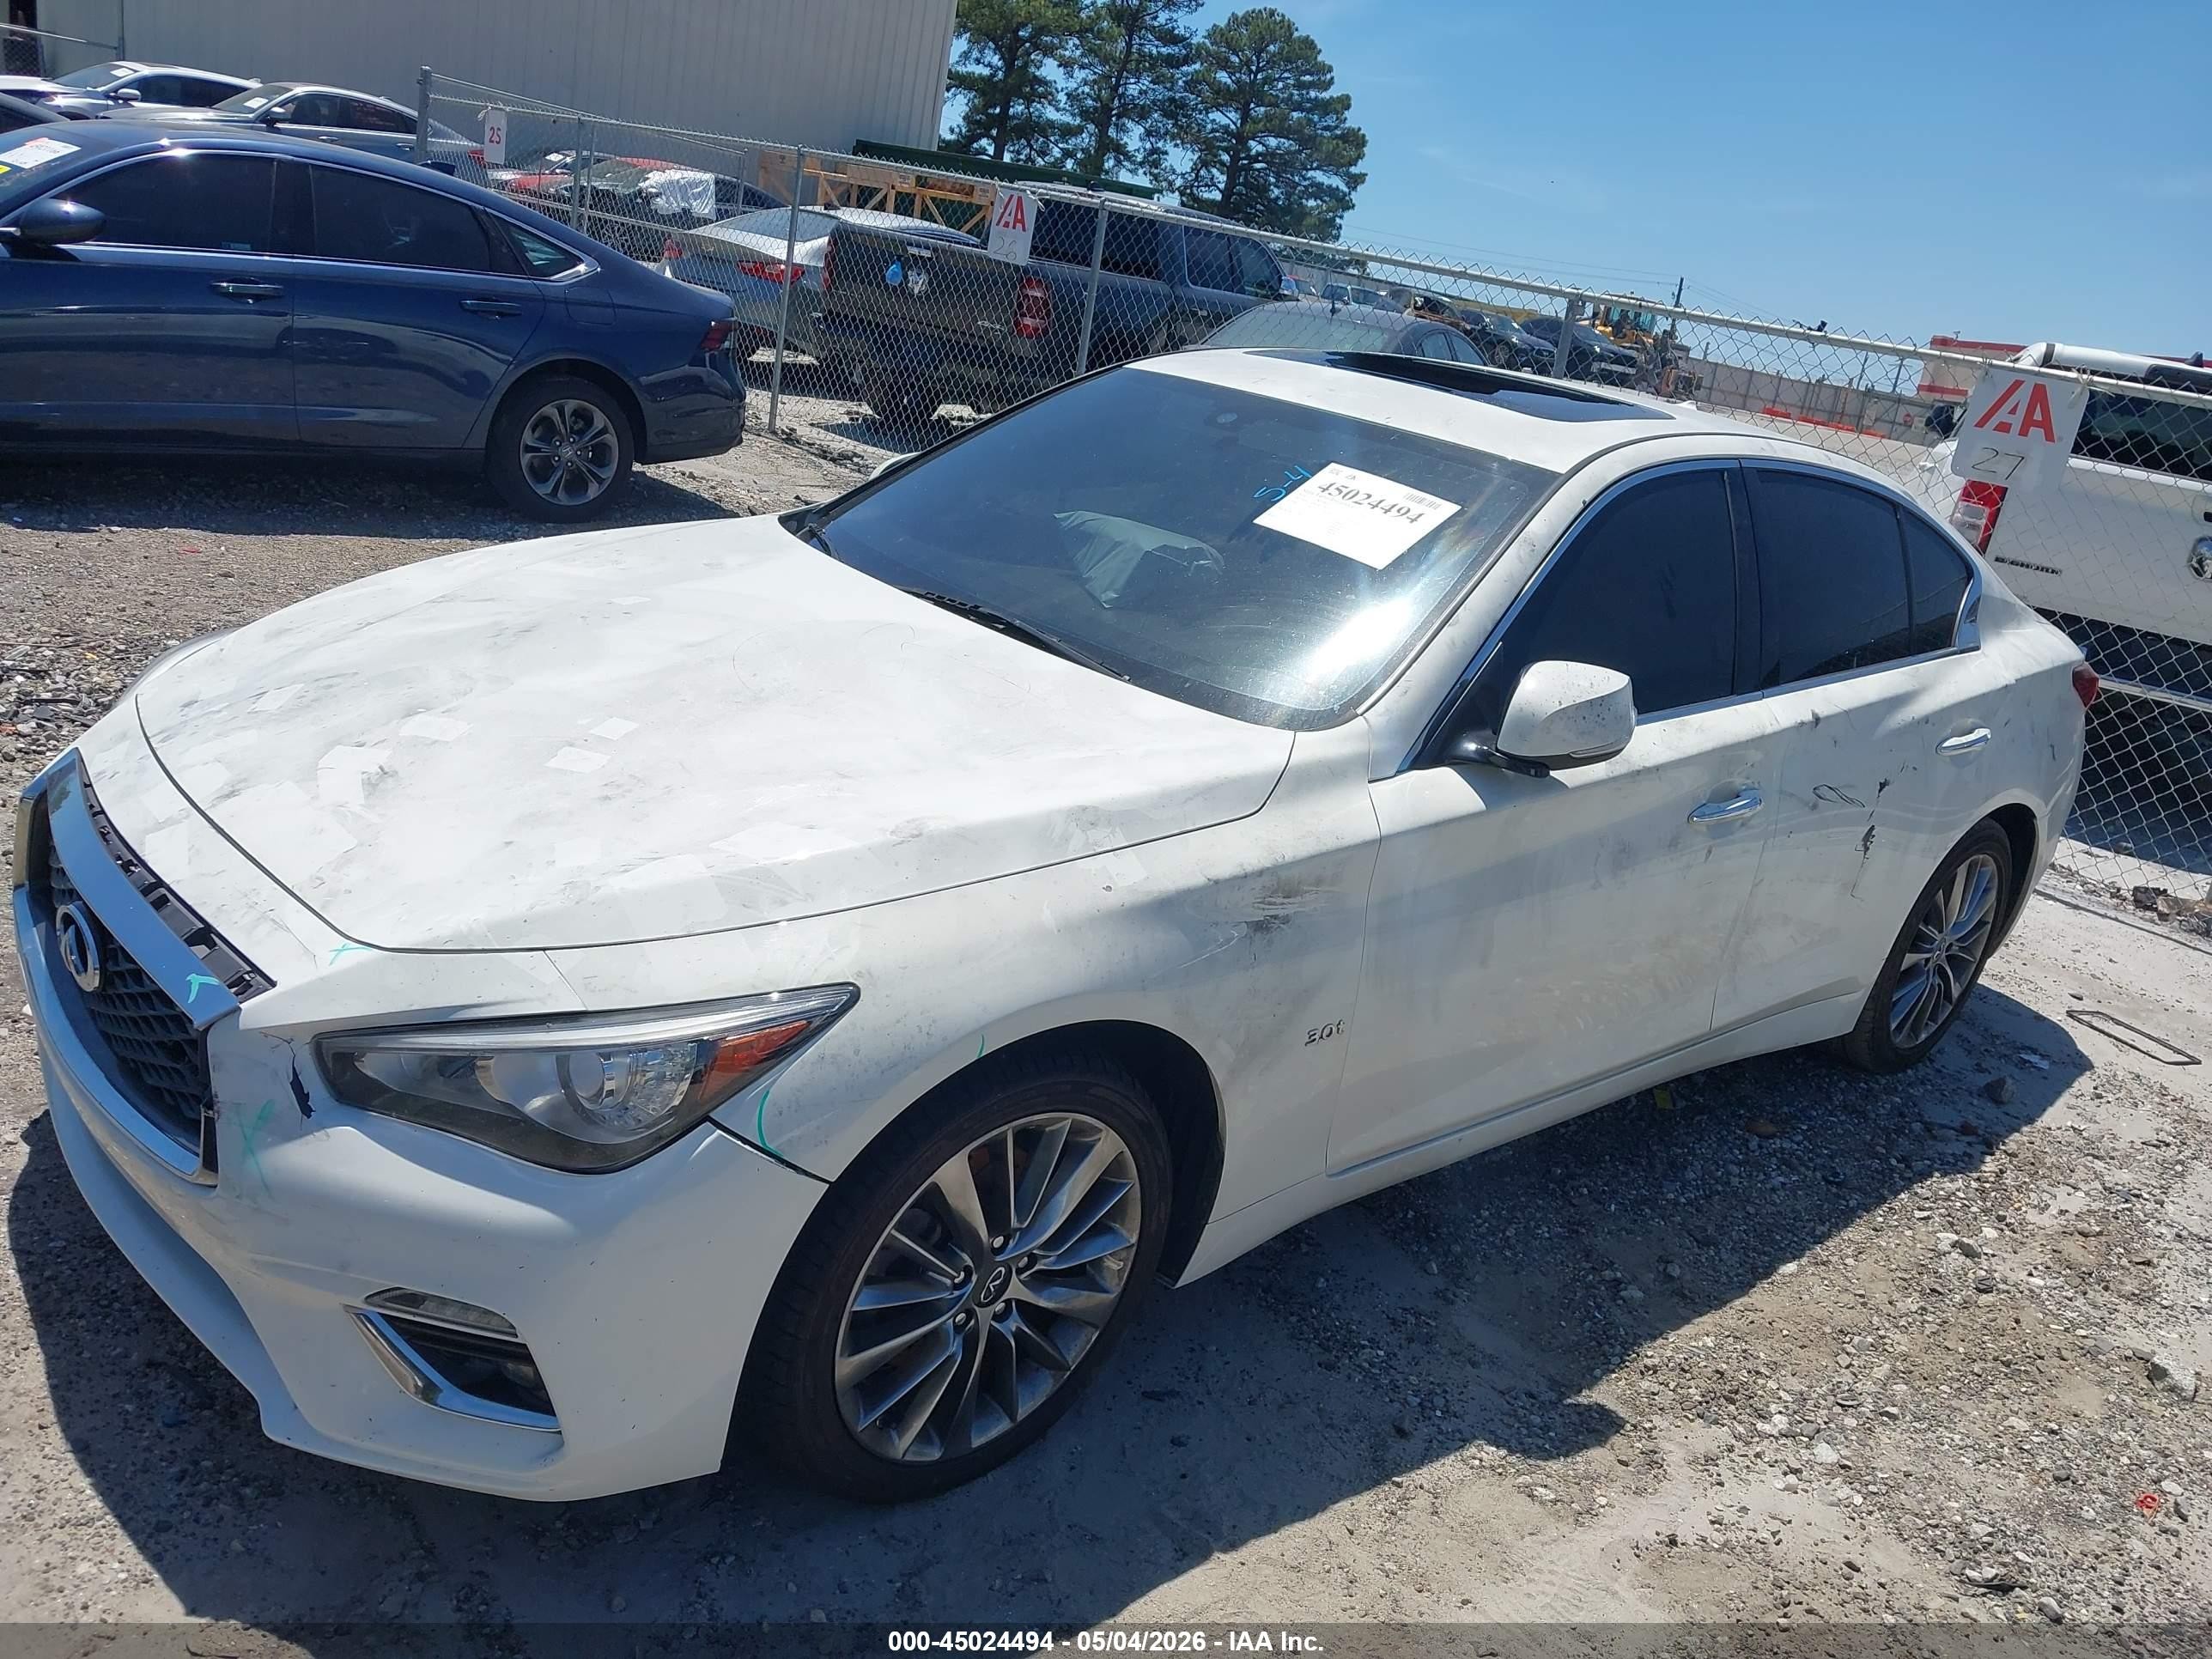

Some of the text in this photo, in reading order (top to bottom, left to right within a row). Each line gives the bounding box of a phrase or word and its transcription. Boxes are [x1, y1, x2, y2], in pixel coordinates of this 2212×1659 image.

[993, 236, 1018, 262] 26
[1971, 447, 2026, 481] 27
[1317, 481, 1425, 525] 45024494
